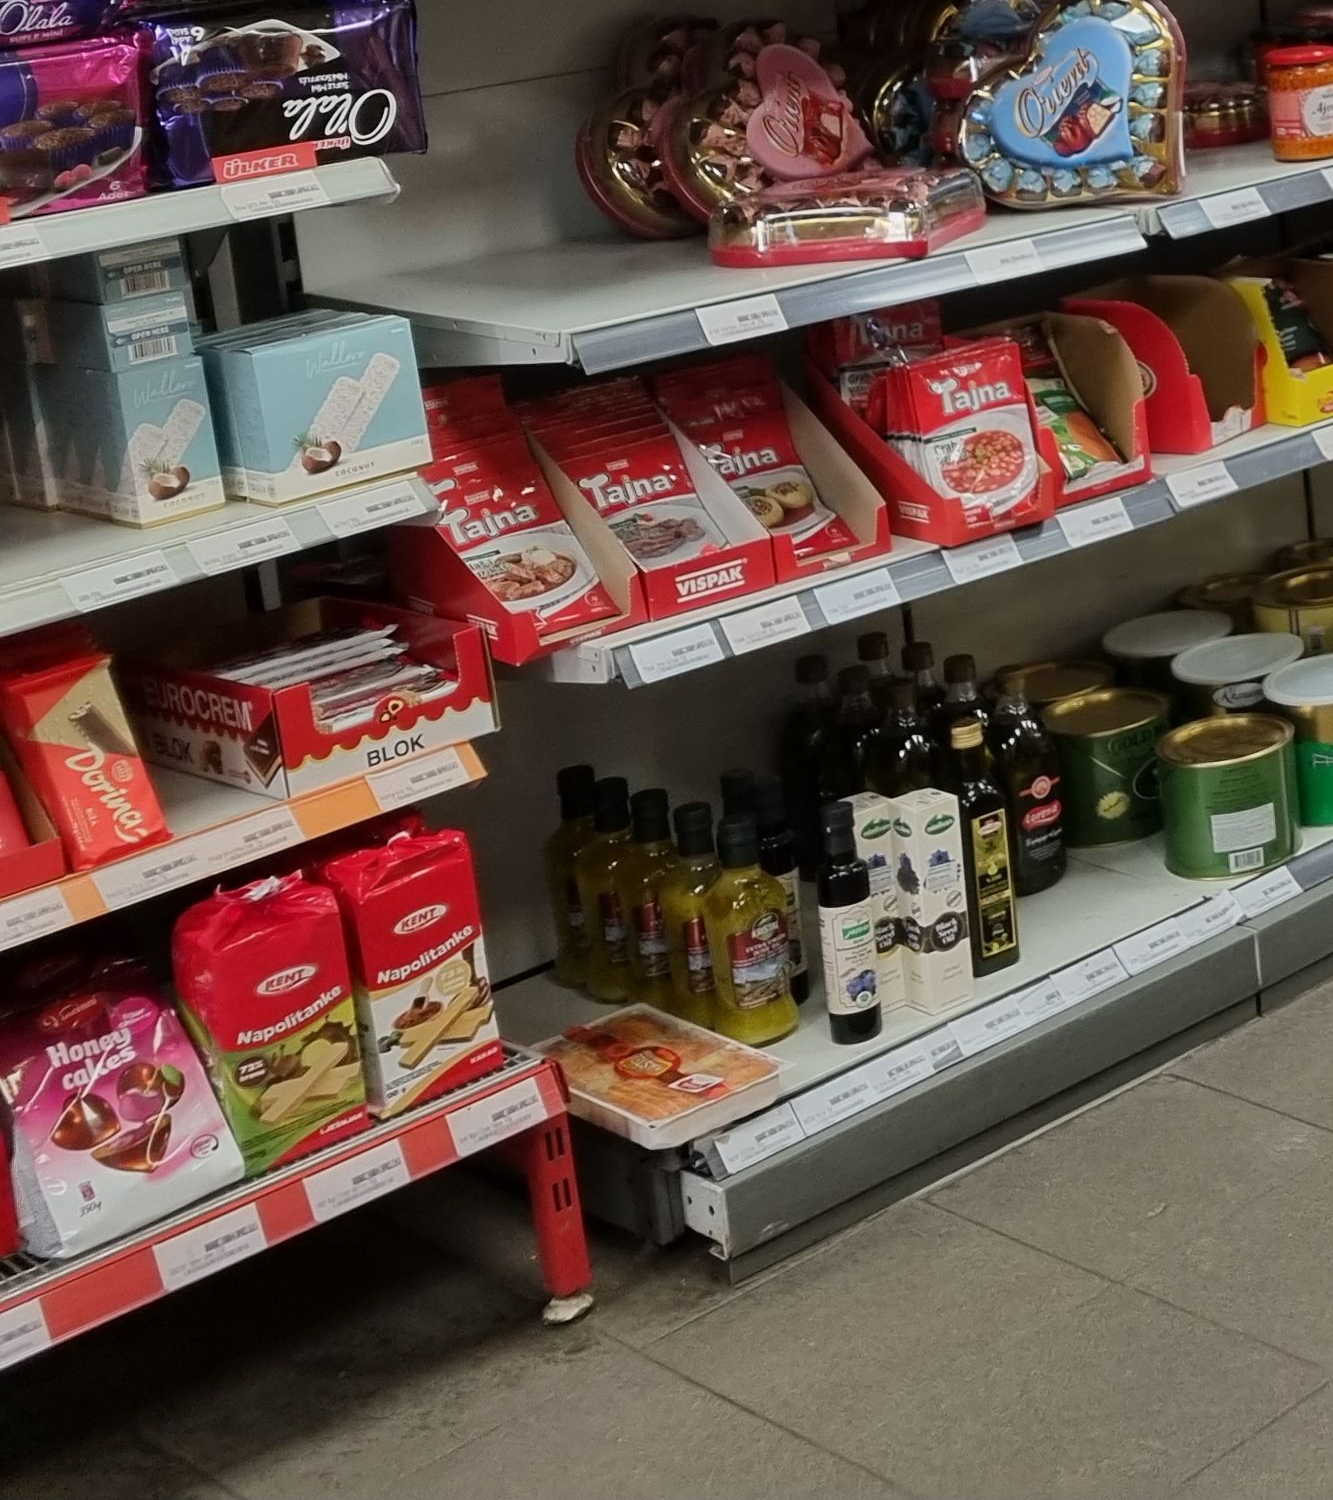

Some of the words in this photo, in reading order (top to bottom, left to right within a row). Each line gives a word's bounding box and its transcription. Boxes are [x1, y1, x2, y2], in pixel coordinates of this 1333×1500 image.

[283, 88, 398, 145] O'lala
[222, 151, 300, 179] ÜLKER
[929, 377, 1012, 416] Tajna
[334, 460, 376, 478] COCONUT
[578, 471, 672, 511] Tajna
[441, 503, 539, 546] Tajna
[676, 564, 744, 597] VISPAK
[366, 732, 426, 769] BLOK
[64, 744, 149, 844] Dorina
[400, 907, 442, 932] KENT
[376, 924, 474, 984] Napolitanke
[262, 968, 309, 993] KENT
[236, 985, 342, 1045] Napolitanke
[46, 1026, 133, 1069] Honey
[61, 1045, 138, 1091] cakes
